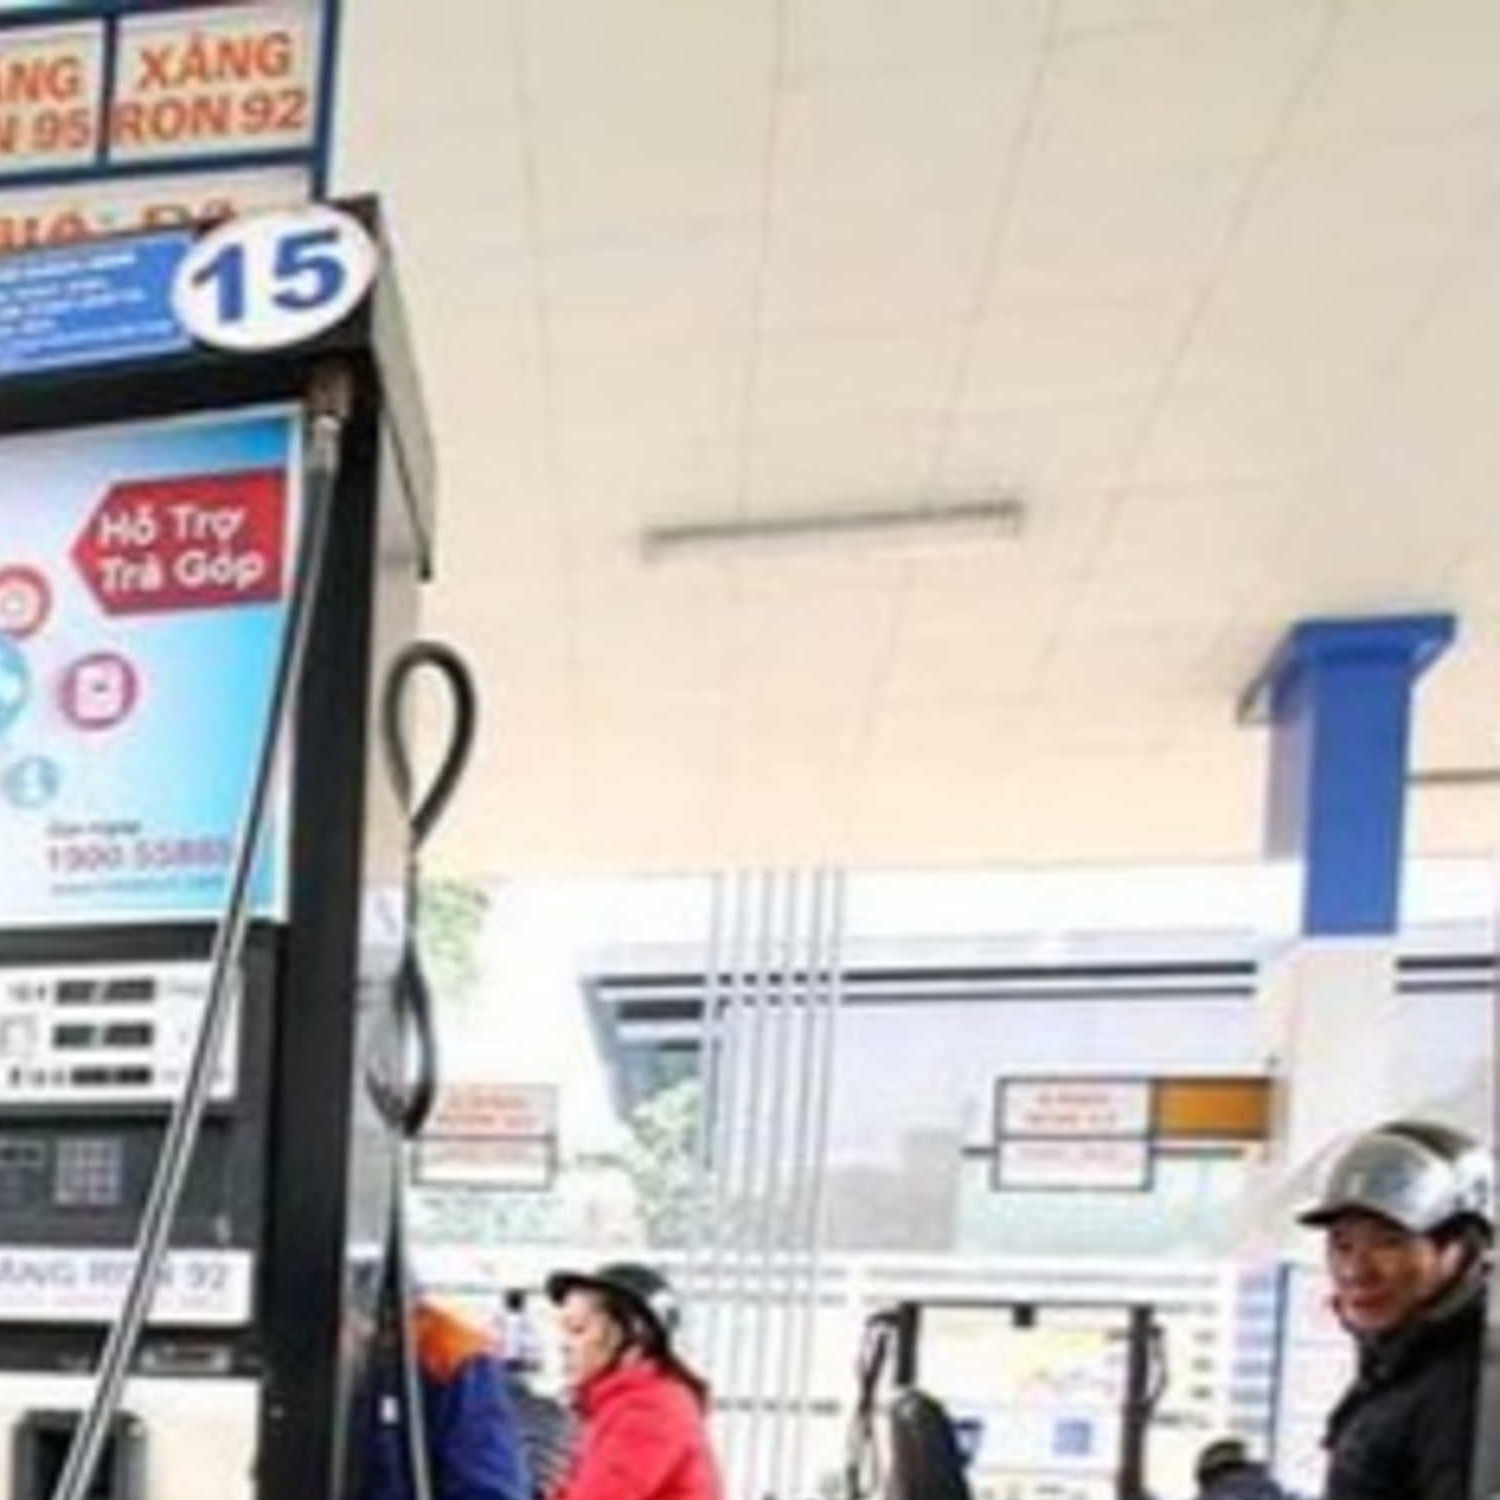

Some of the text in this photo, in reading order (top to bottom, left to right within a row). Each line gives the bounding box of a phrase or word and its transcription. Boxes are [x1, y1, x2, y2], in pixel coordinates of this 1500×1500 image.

[31, 109, 91, 149] 95
[113, 89, 308, 144] RON 92
[192, 224, 345, 322] 15
